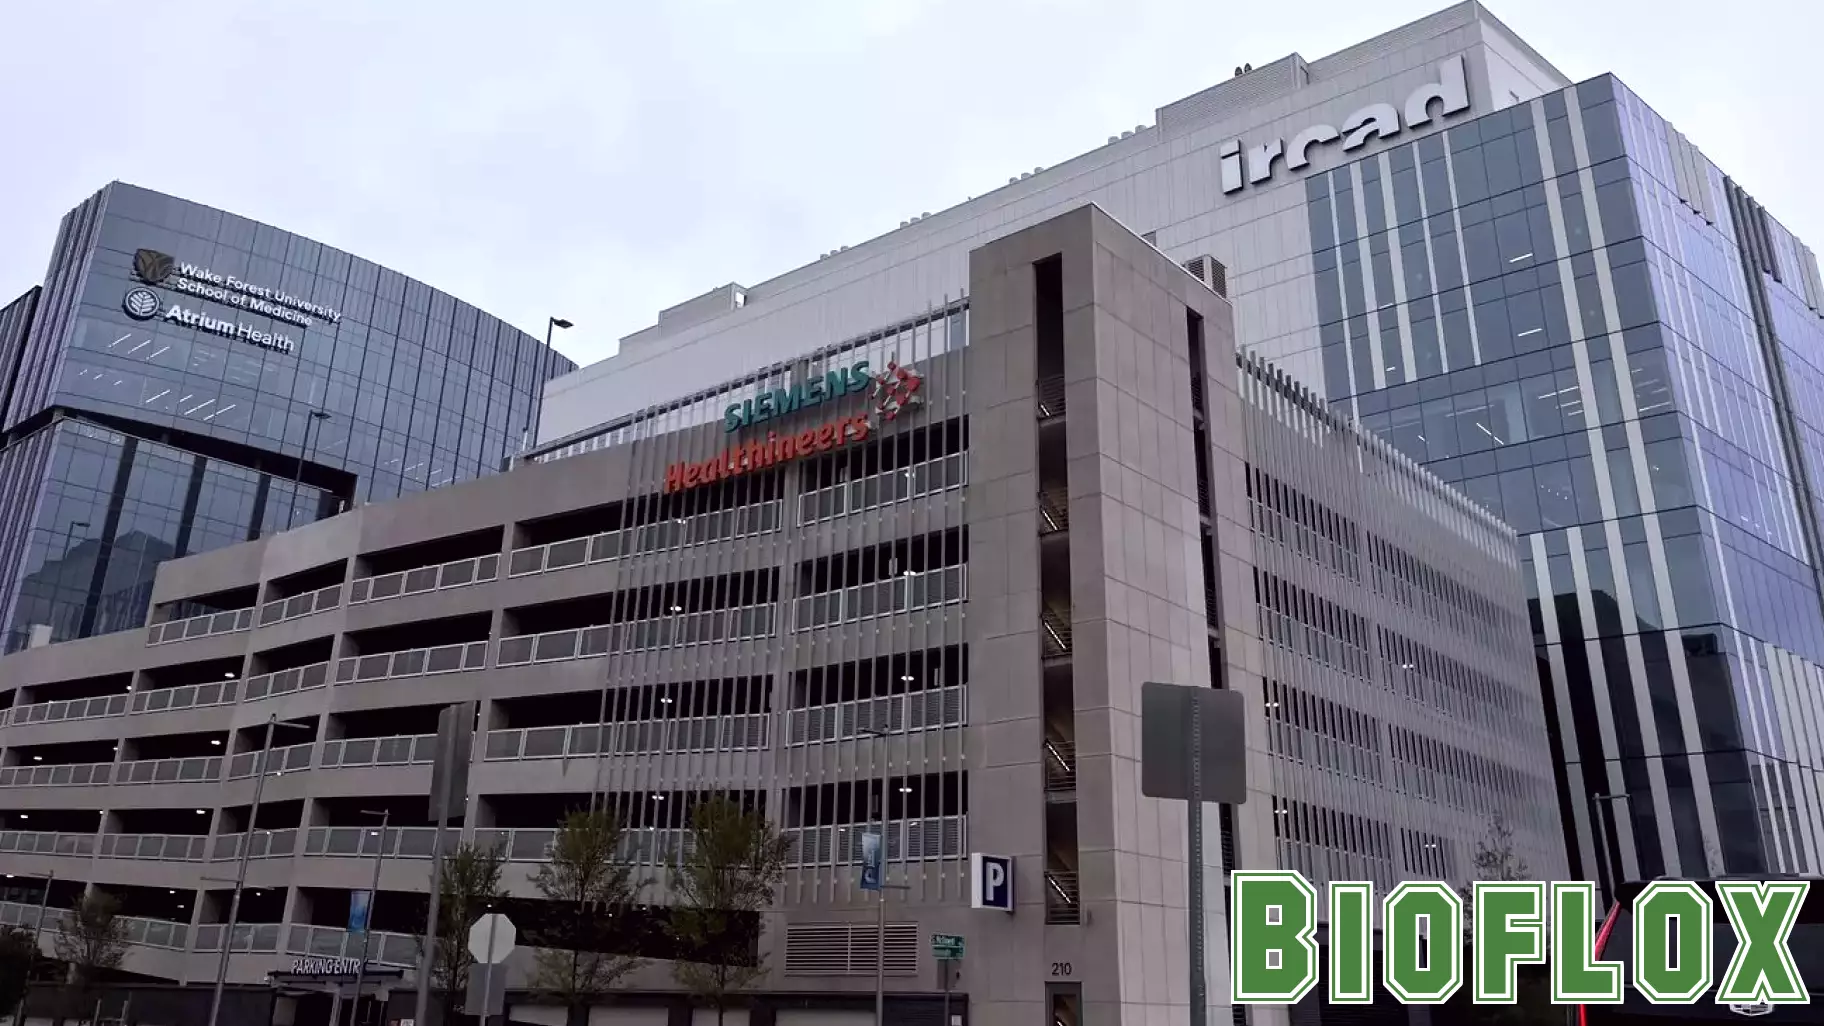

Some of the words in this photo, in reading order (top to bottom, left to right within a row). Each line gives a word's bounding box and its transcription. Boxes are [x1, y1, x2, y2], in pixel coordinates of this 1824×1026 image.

[1220, 54, 1470, 194] ircad
[177, 278, 227, 301] School
[231, 293, 247, 306] of
[250, 299, 313, 327] Medicine
[181, 262, 222, 283] Wake
[225, 275, 271, 298] Forest
[275, 291, 342, 323] University
[166, 304, 235, 335] Atrium
[237, 321, 295, 351] Health
[724, 360, 870, 433] SIEMENS
[664, 412, 871, 493] Healthineers
[985, 862, 1004, 901] P
[290, 958, 333, 975] PARKING
[334, 957, 367, 974] ENTR
[1051, 962, 1072, 976] 210
